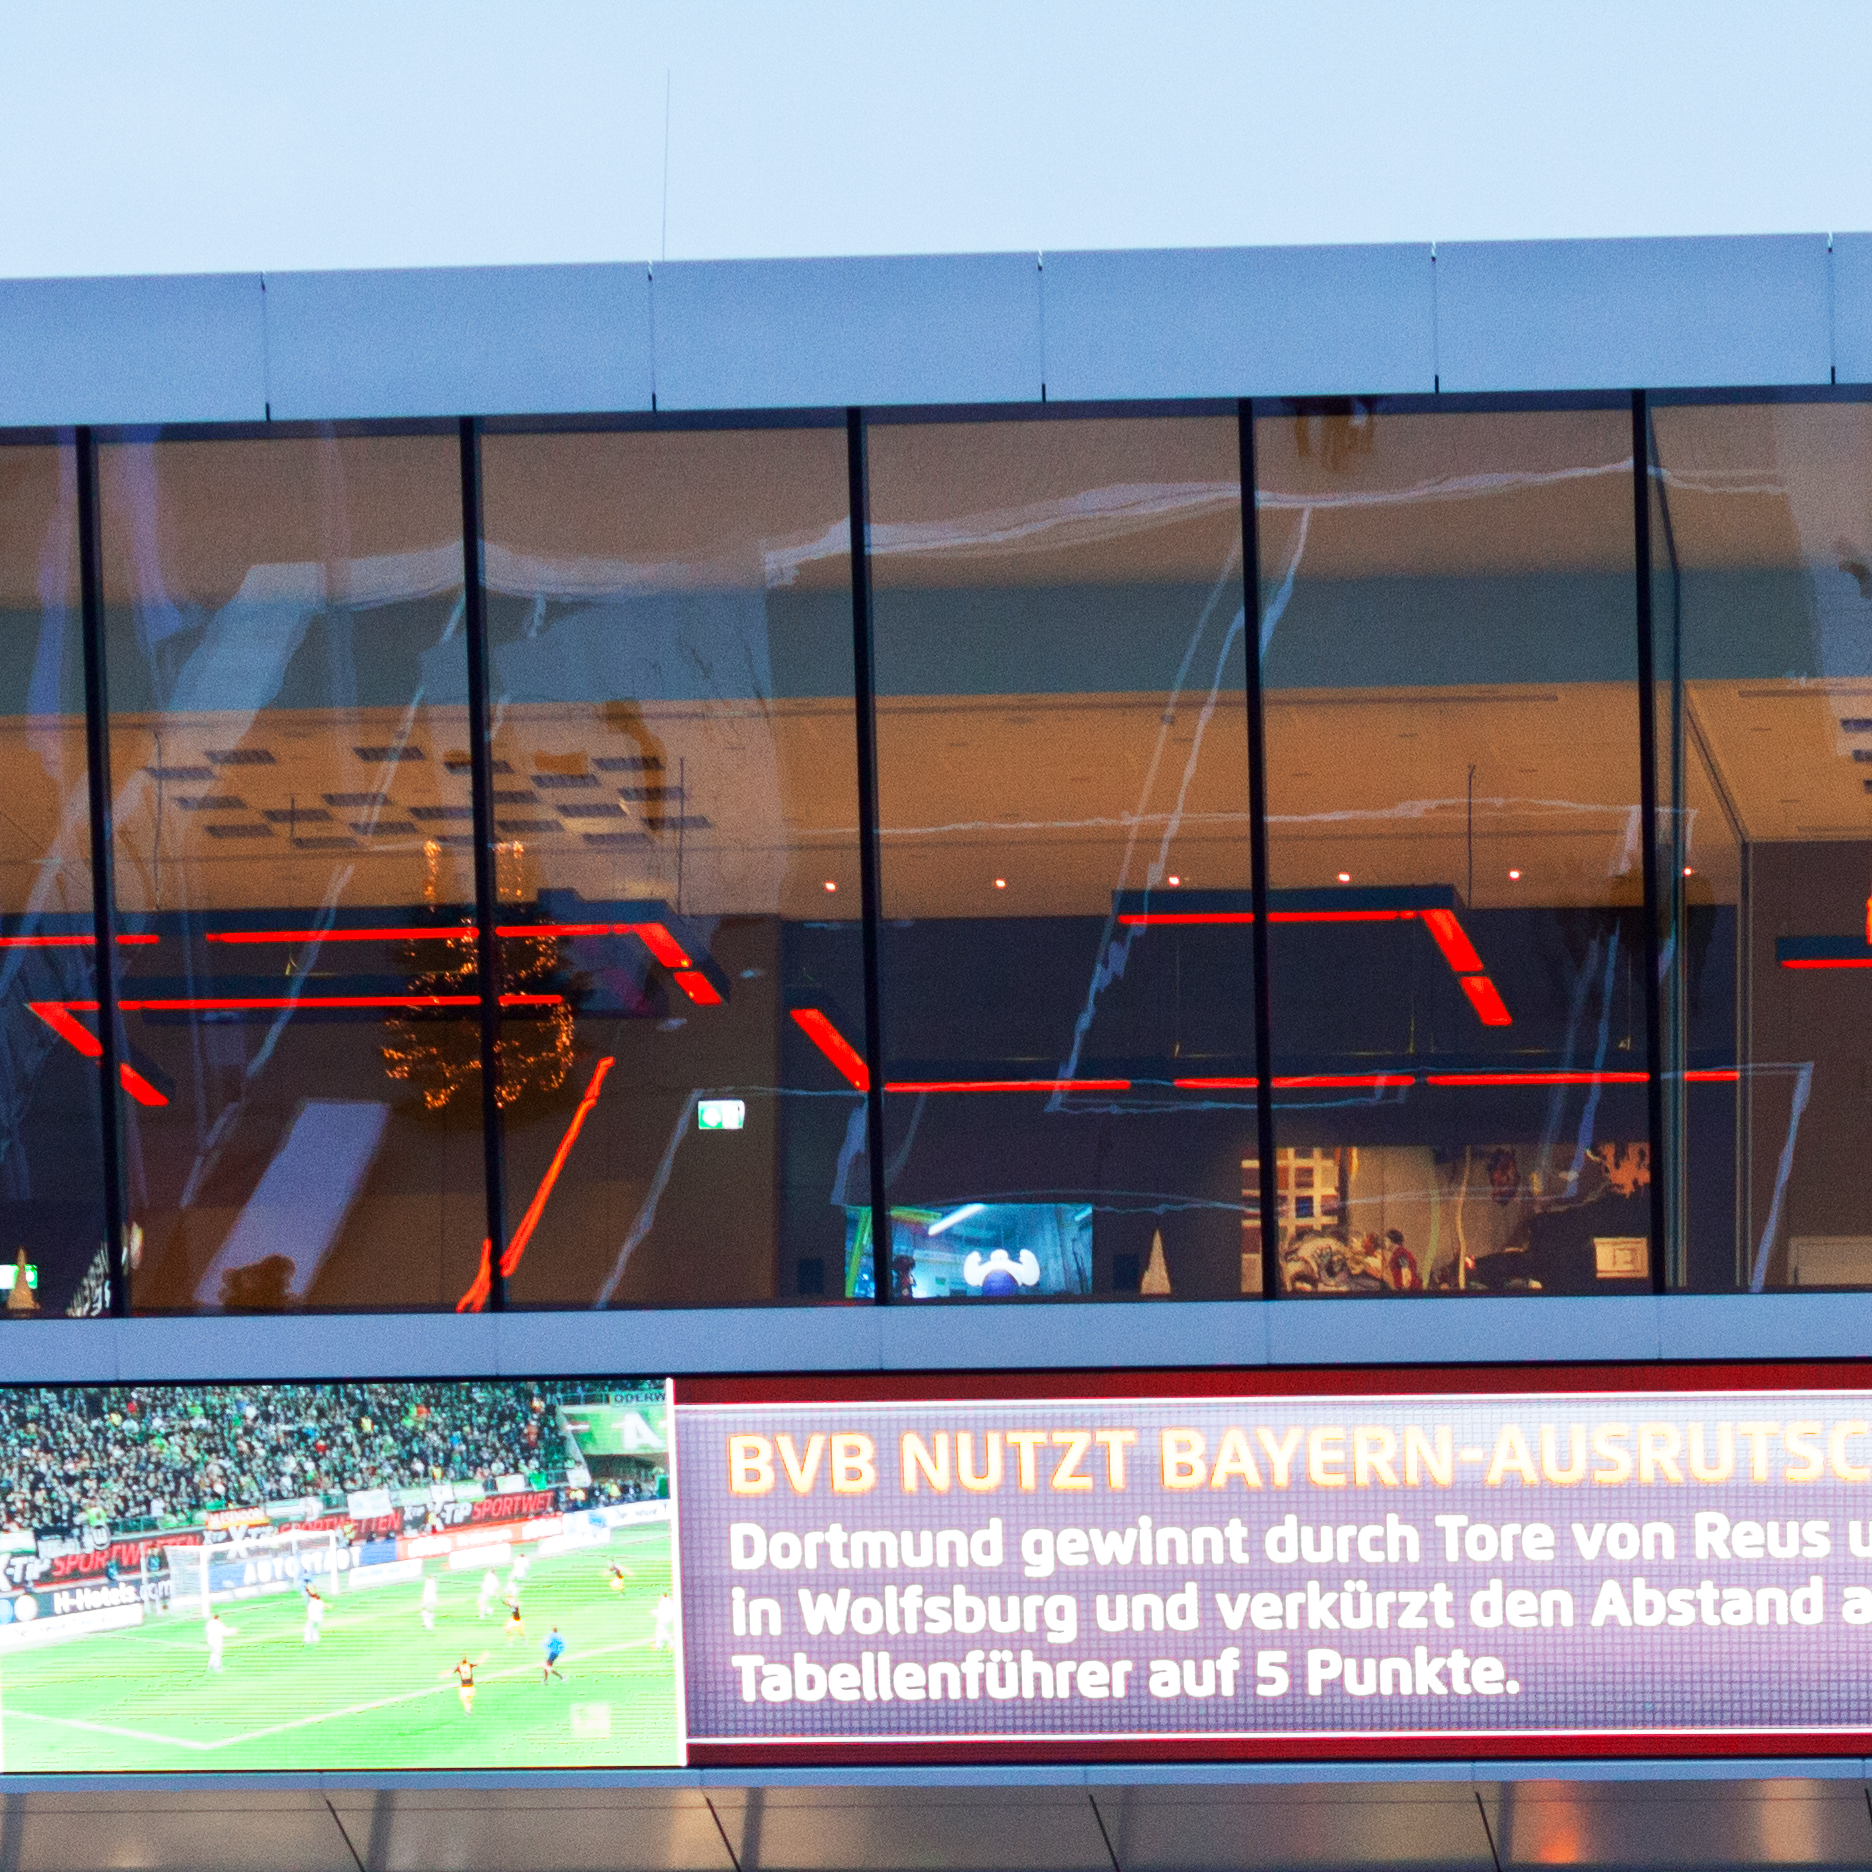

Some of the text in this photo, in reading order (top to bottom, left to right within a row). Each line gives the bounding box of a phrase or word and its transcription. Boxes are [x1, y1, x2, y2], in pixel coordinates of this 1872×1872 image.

[728, 1432, 876, 1496] BVB
[900, 1429, 1137, 1494] NUTZT
[730, 1517, 1003, 1570] Dortmund
[1021, 1514, 1250, 1578] gewinnt
[1264, 1512, 1421, 1566] durch
[1434, 1513, 1556, 1563] Tore
[1572, 1517, 1675, 1560] von
[1694, 1510, 1830, 1560] Reus
[731, 1587, 782, 1638] in
[797, 1583, 1079, 1644] Wolfsburg
[1095, 1580, 1198, 1632] und
[1215, 1580, 1455, 1630] verkürzt
[1470, 1579, 1574, 1628] den
[1590, 1577, 1825, 1627] Abstand
[731, 1647, 1521, 1704] Tabellenführer auf 5 Punkte.
